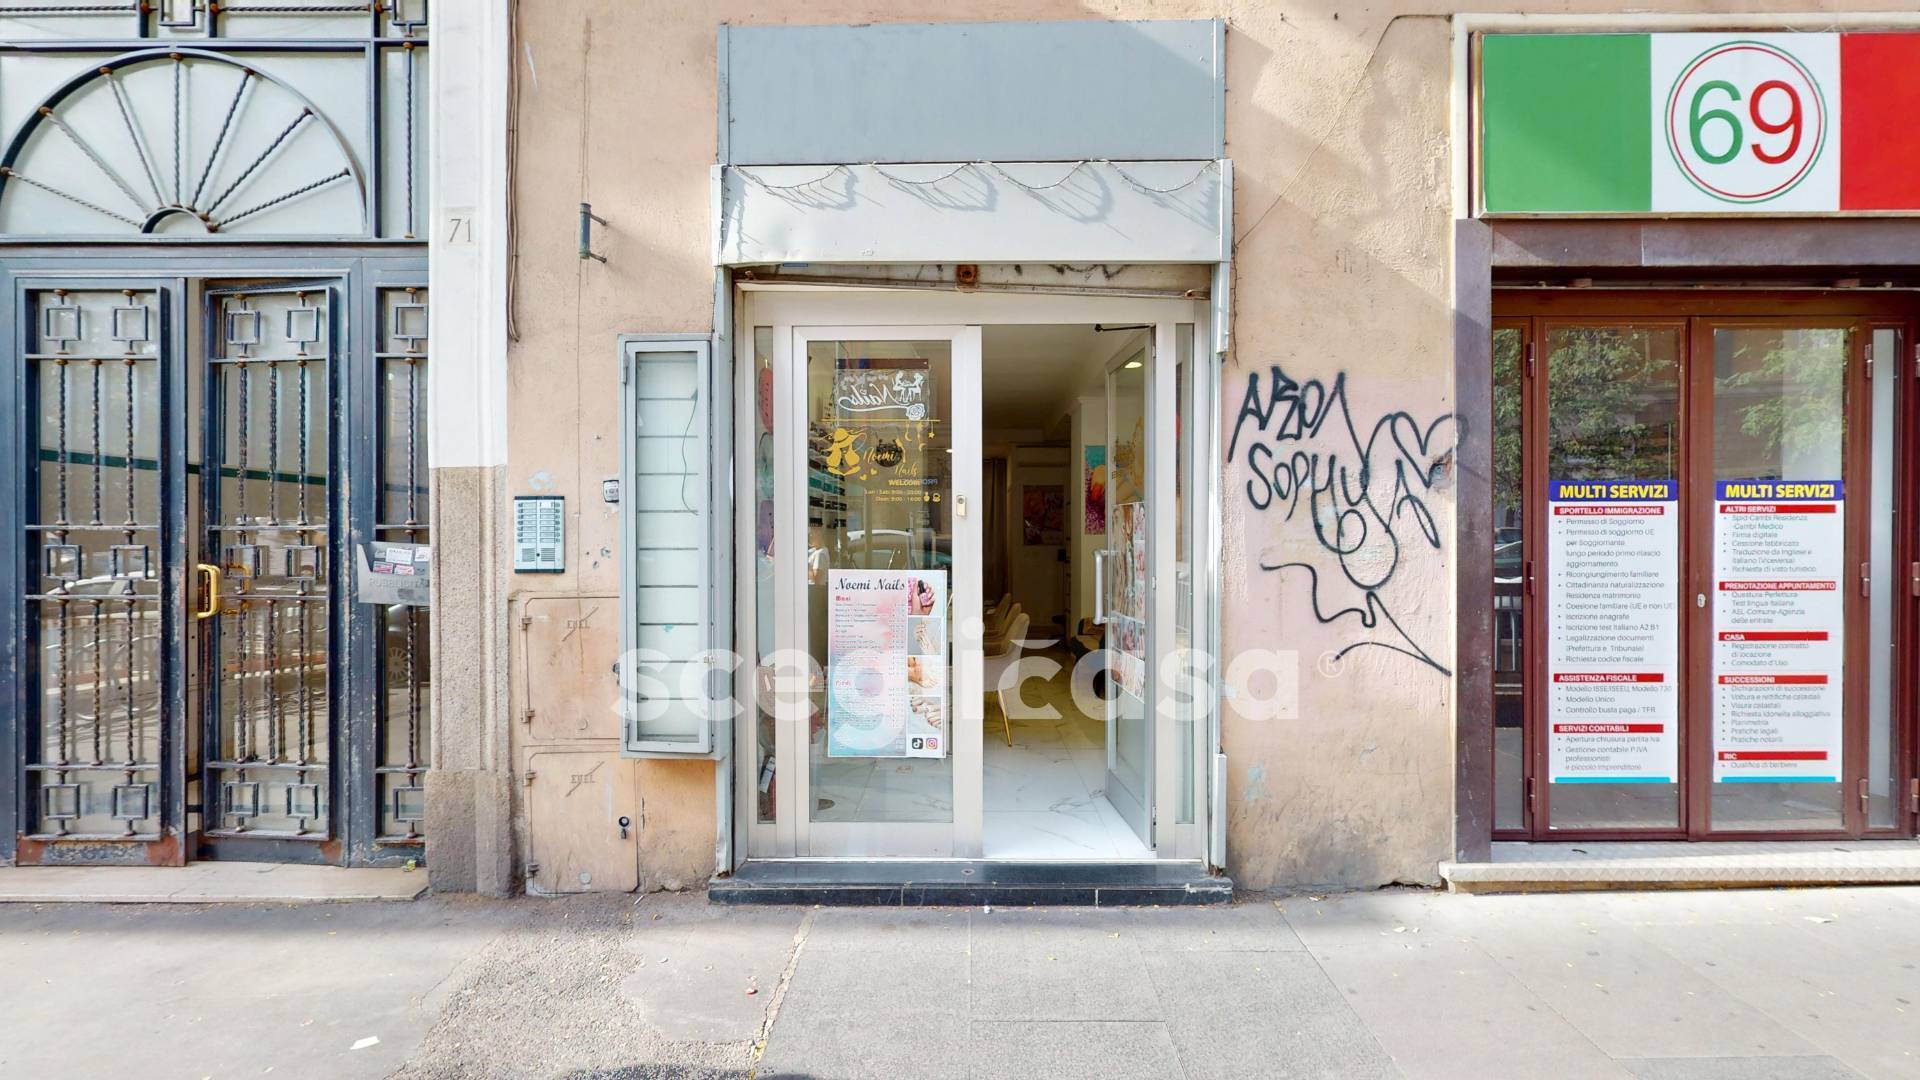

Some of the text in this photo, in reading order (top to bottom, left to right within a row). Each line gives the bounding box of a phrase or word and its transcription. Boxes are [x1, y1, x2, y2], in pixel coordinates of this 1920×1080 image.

[1689, 80, 1803, 165] 69
[449, 218, 472, 242] 71
[1559, 485, 1668, 498] MULTI SERVIZI
[1725, 484, 1834, 498] MULTI SERVIZI
[835, 578, 905, 590] Noemi Nails
[1749, 600, 1768, 608] lingua
